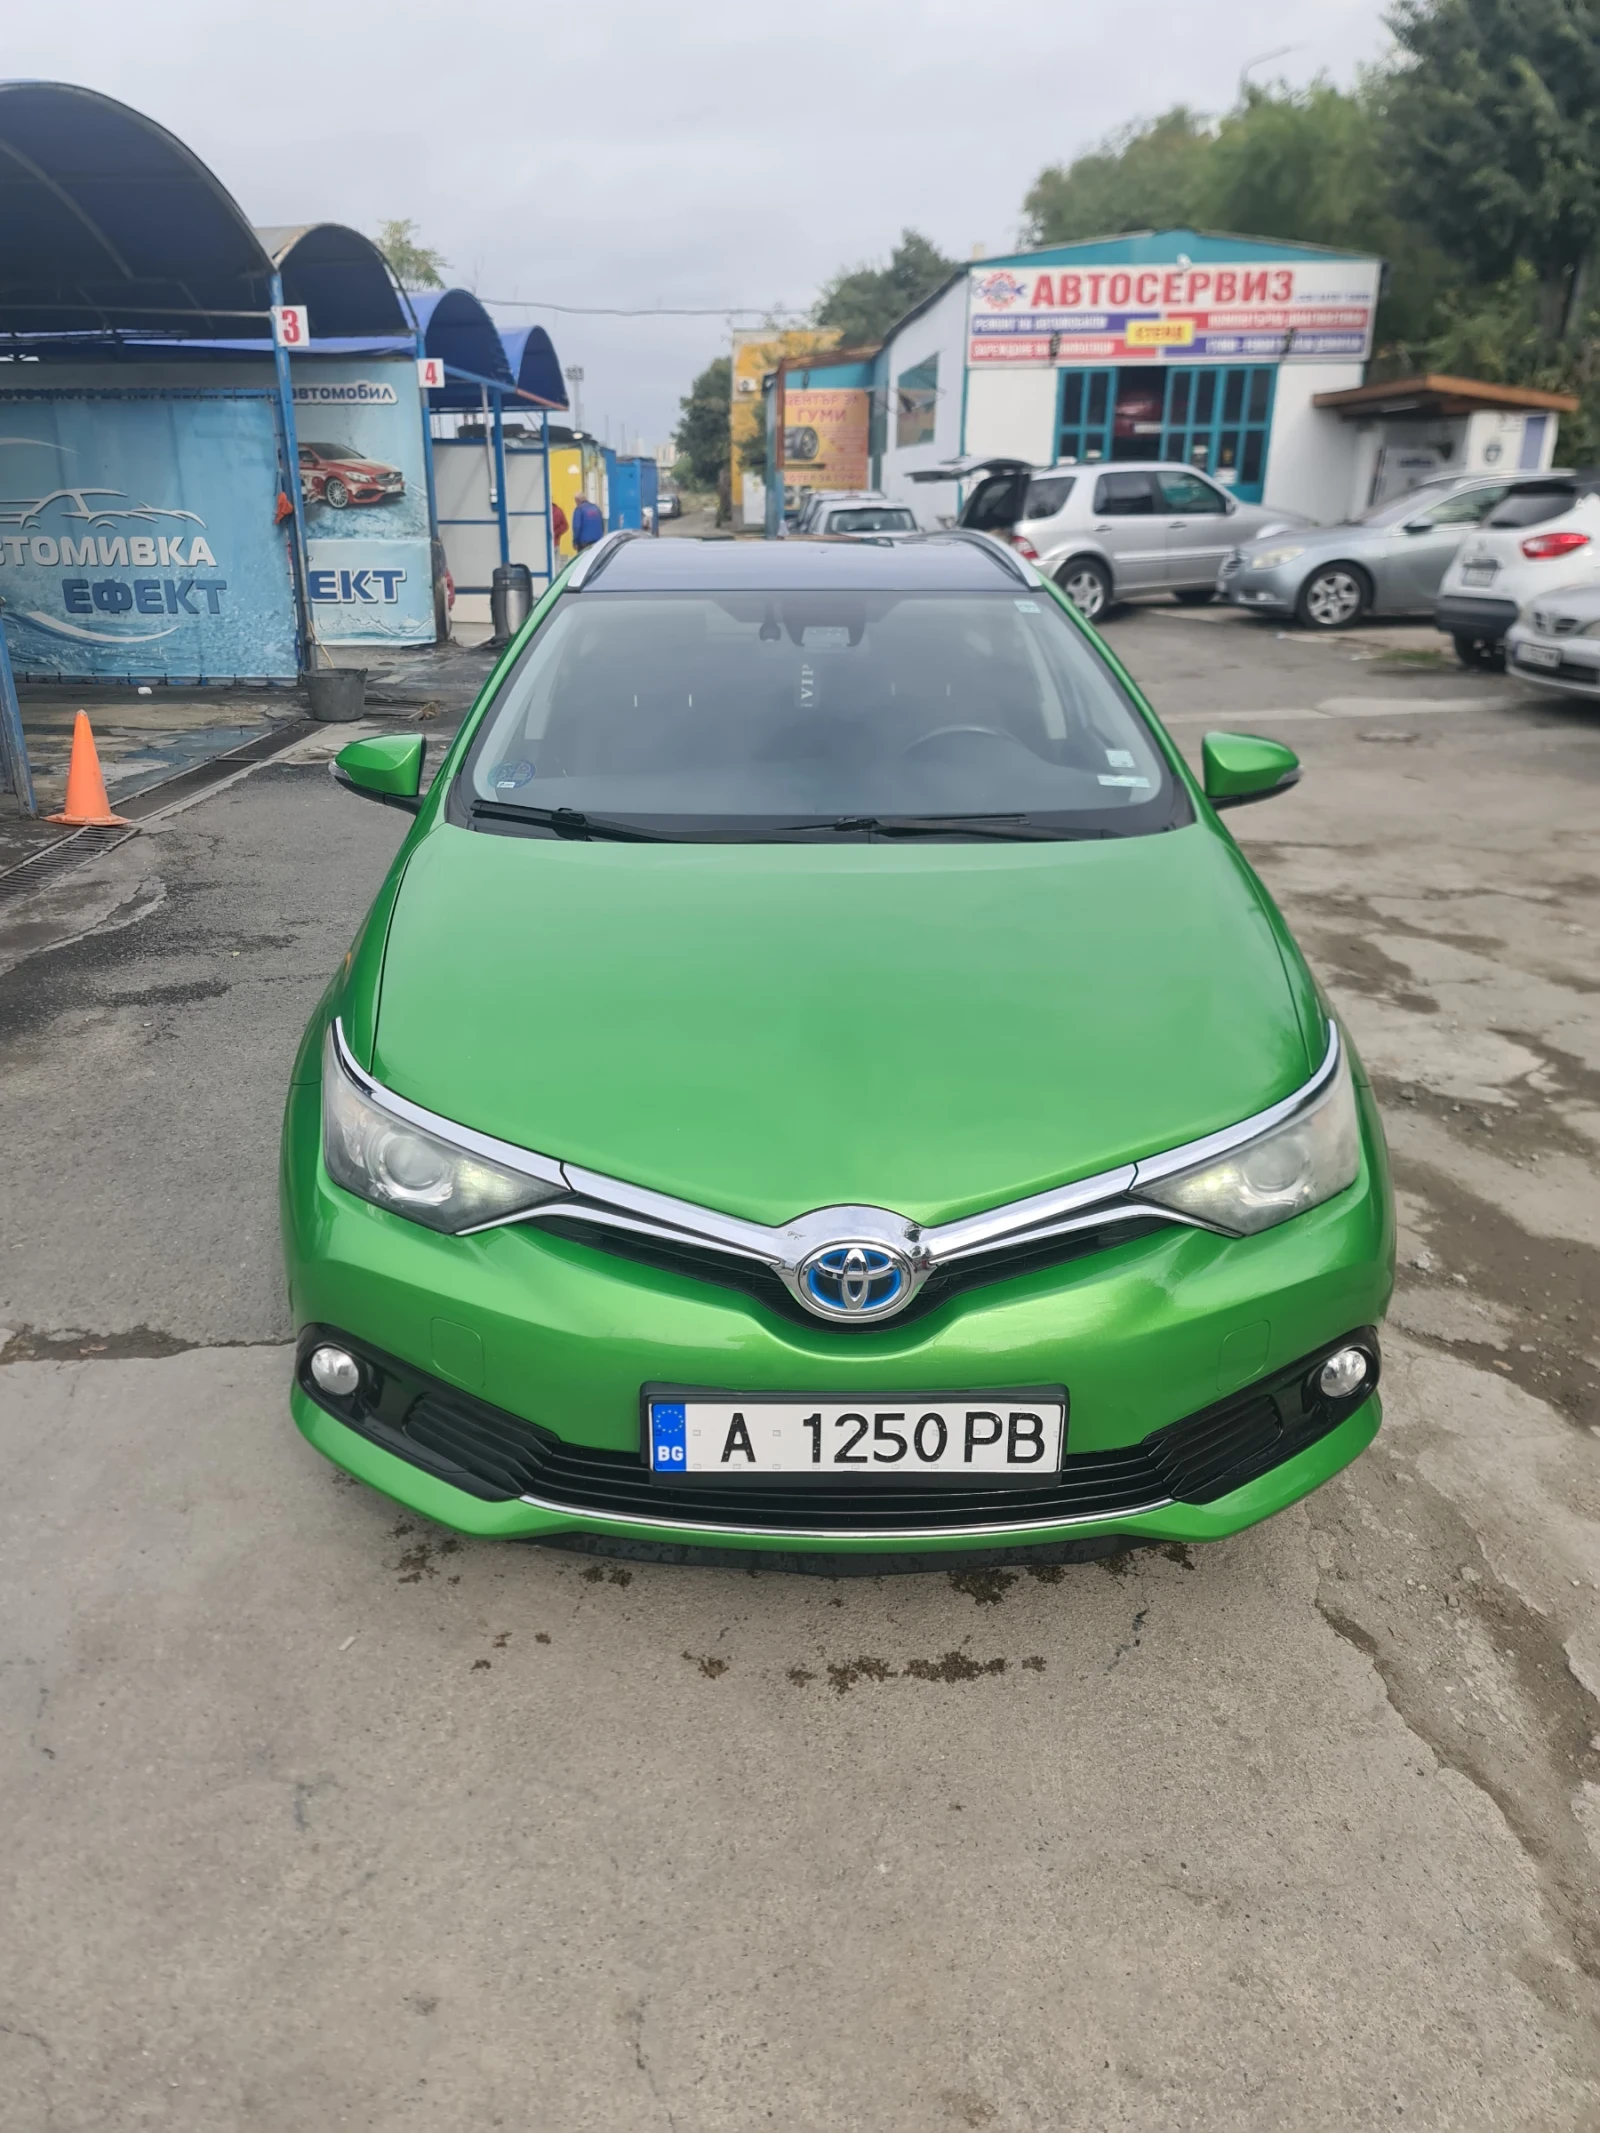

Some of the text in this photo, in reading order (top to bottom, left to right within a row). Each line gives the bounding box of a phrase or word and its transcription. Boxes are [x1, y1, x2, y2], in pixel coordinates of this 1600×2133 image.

[1031, 271, 1293, 307] АВТОСЕРВИЗ
[282, 310, 300, 344] 3
[425, 362, 438, 385] 4
[798, 409, 847, 423] ГУМИ
[0, 536, 218, 567] ТОМИВКА
[61, 579, 227, 614] ЕФЕКТ
[657, 1447, 685, 1462] BG
